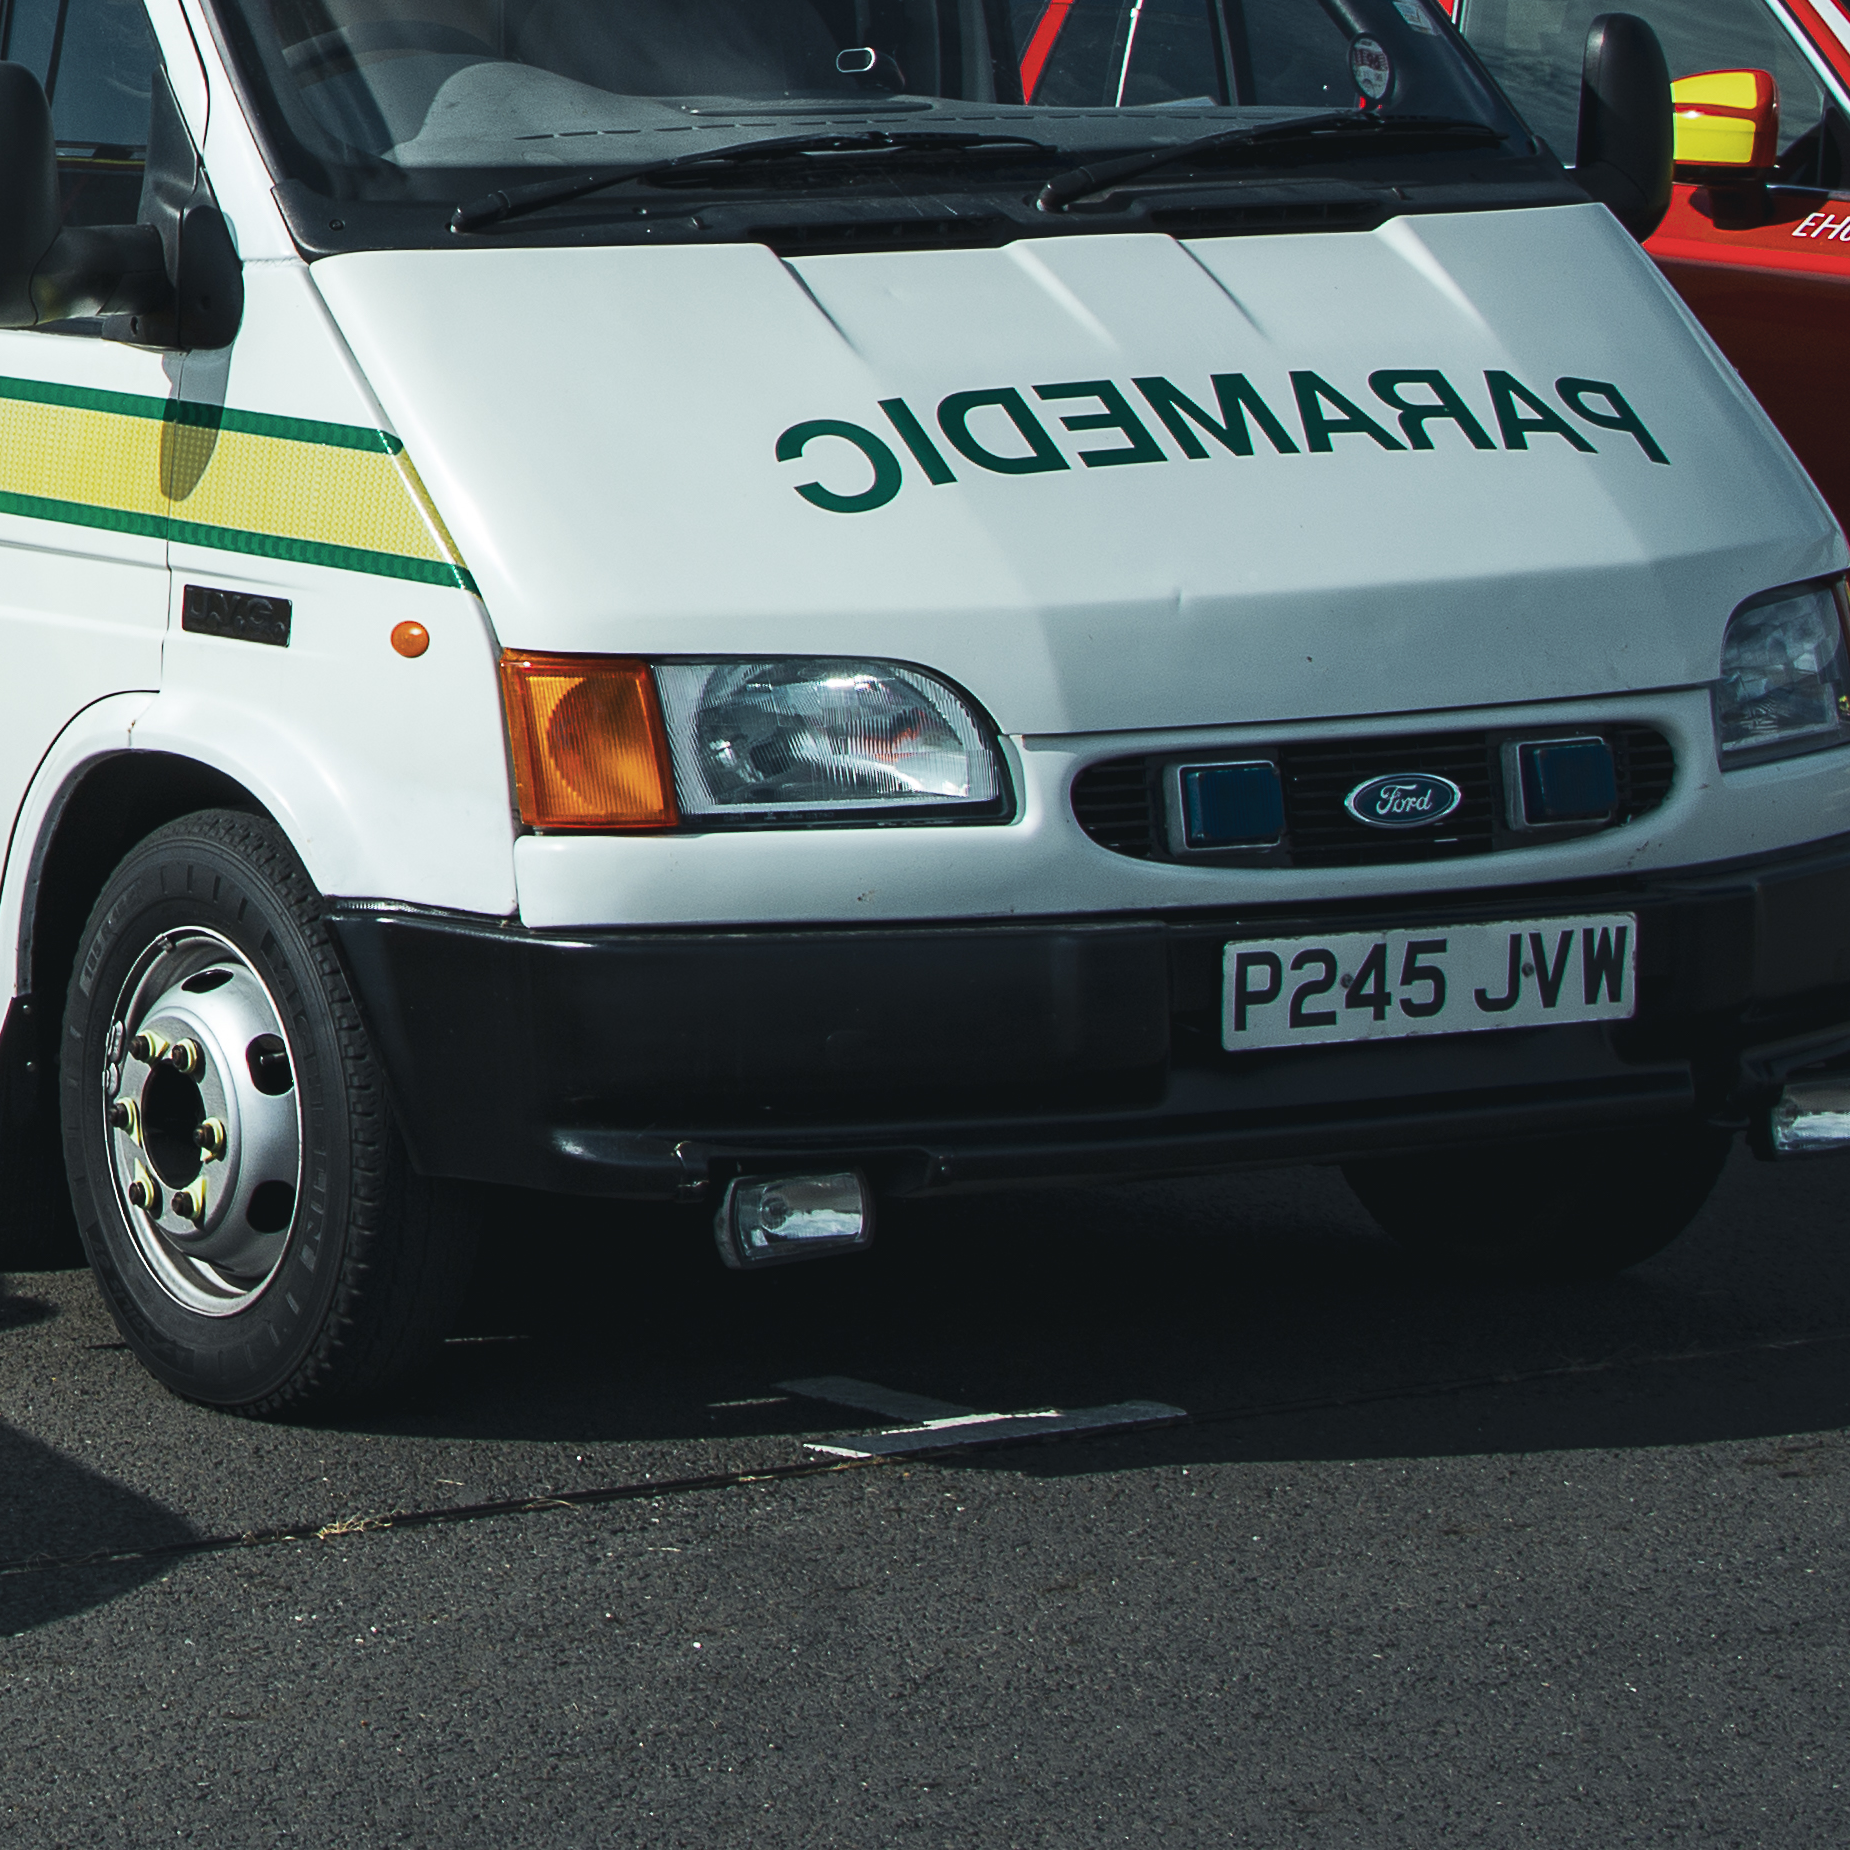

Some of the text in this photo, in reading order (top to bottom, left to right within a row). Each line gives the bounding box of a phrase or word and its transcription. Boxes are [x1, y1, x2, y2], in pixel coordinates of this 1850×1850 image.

[1375, 783, 1434, 816] Ford
[1233, 925, 1629, 1032] P245 JVW
